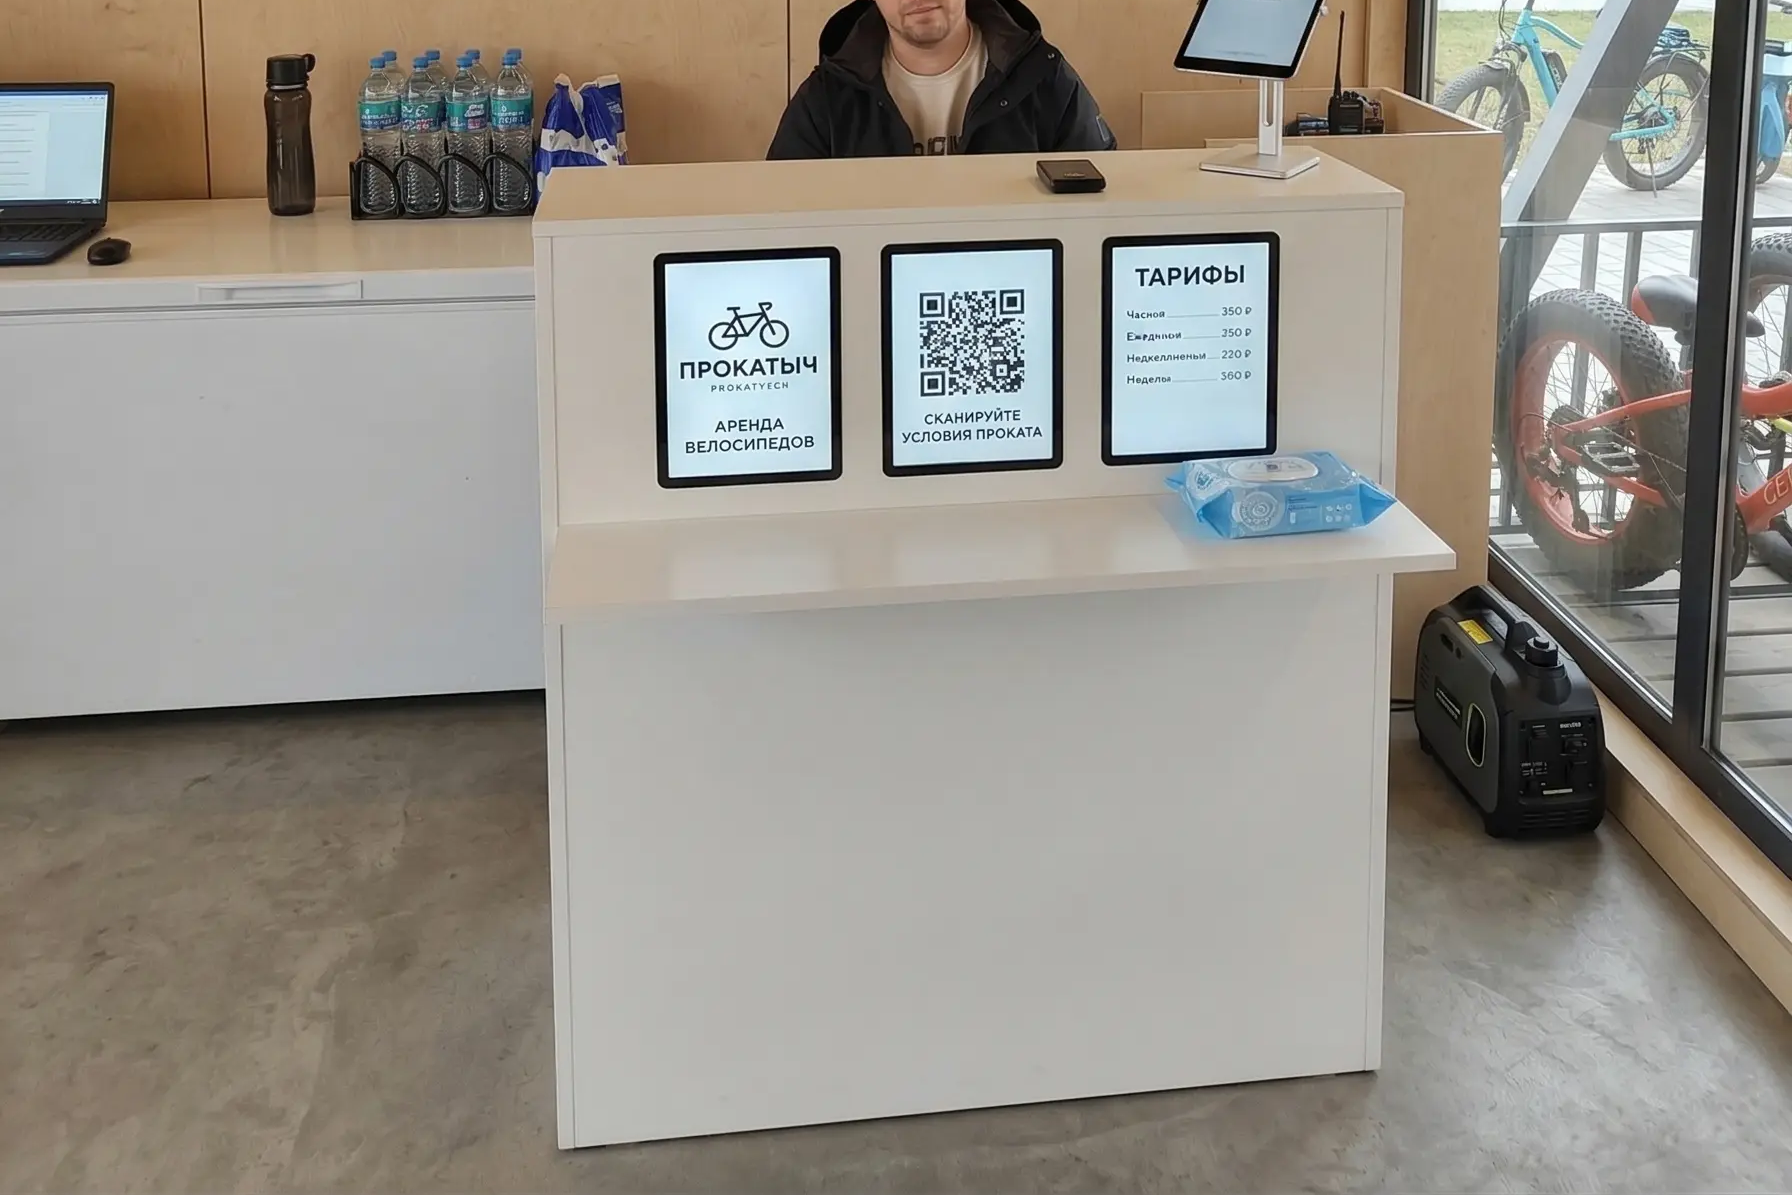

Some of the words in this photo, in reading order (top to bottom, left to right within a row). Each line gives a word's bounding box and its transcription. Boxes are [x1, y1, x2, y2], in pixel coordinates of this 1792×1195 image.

[1135, 264, 1245, 287] ТАРИФЫ
[1221, 306, 1242, 316] 350
[1221, 349, 1242, 359] 220
[680, 356, 818, 380] ПРОКАТЫЧ
[711, 382, 789, 393] PROKATYECH
[715, 417, 784, 433] АРЕНДА
[924, 408, 1021, 425] СКАНИРУЙТЕ
[902, 429, 972, 444] УСЛОВИЯ
[976, 426, 1043, 440] ПРОКАТА
[685, 435, 815, 454] ВЕЛОСИПЕДОВ
